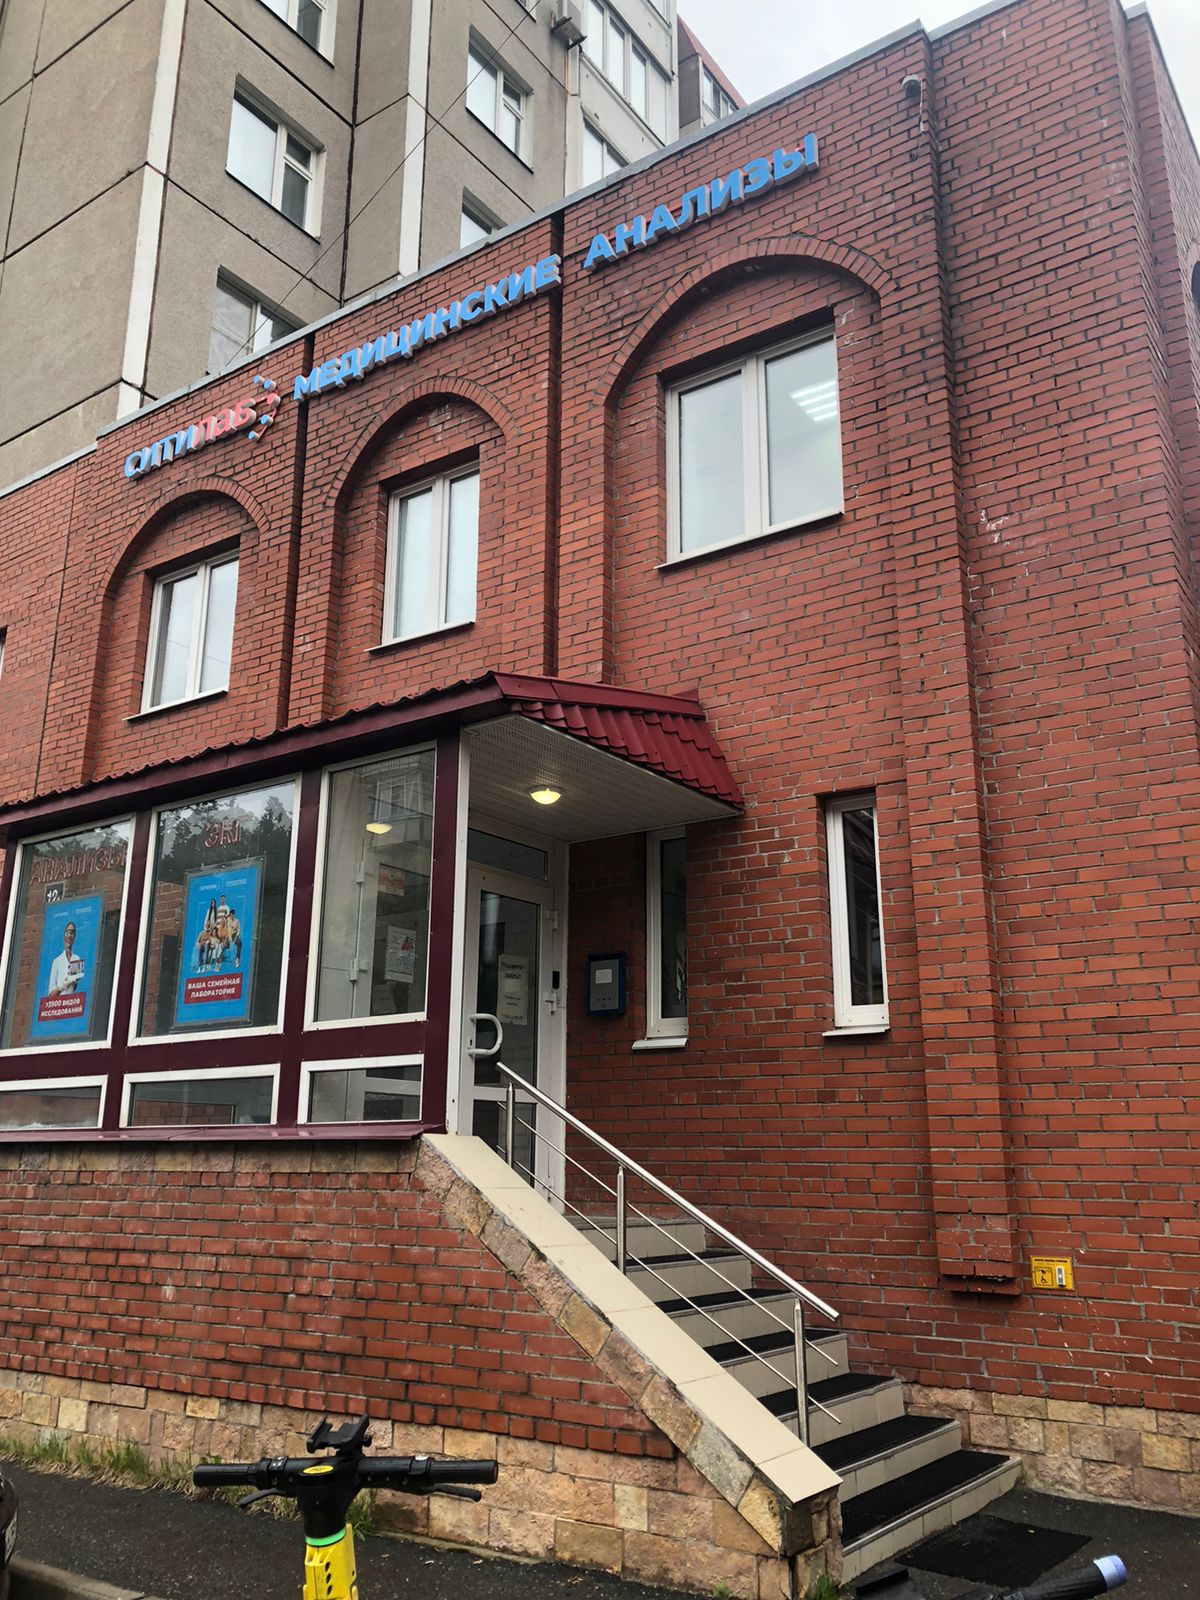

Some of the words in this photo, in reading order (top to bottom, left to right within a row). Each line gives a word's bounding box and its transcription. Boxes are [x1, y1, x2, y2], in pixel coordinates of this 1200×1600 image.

[293, 254, 562, 401] МЕДИЦИНСКИЕ
[583, 131, 819, 270] АНАЛИЗЫ
[29, 844, 128, 885] АНАЛИЗЫ
[187, 982, 206, 990] ВАША
[207, 977, 240, 988] СЕМЕЙНАЯ
[190, 987, 236, 998] ЛАБОРАТОРИЯ
[62, 998, 80, 1006] ВИДОВ
[40, 1005, 83, 1017] ИССЛЕДОВАНИЙ
